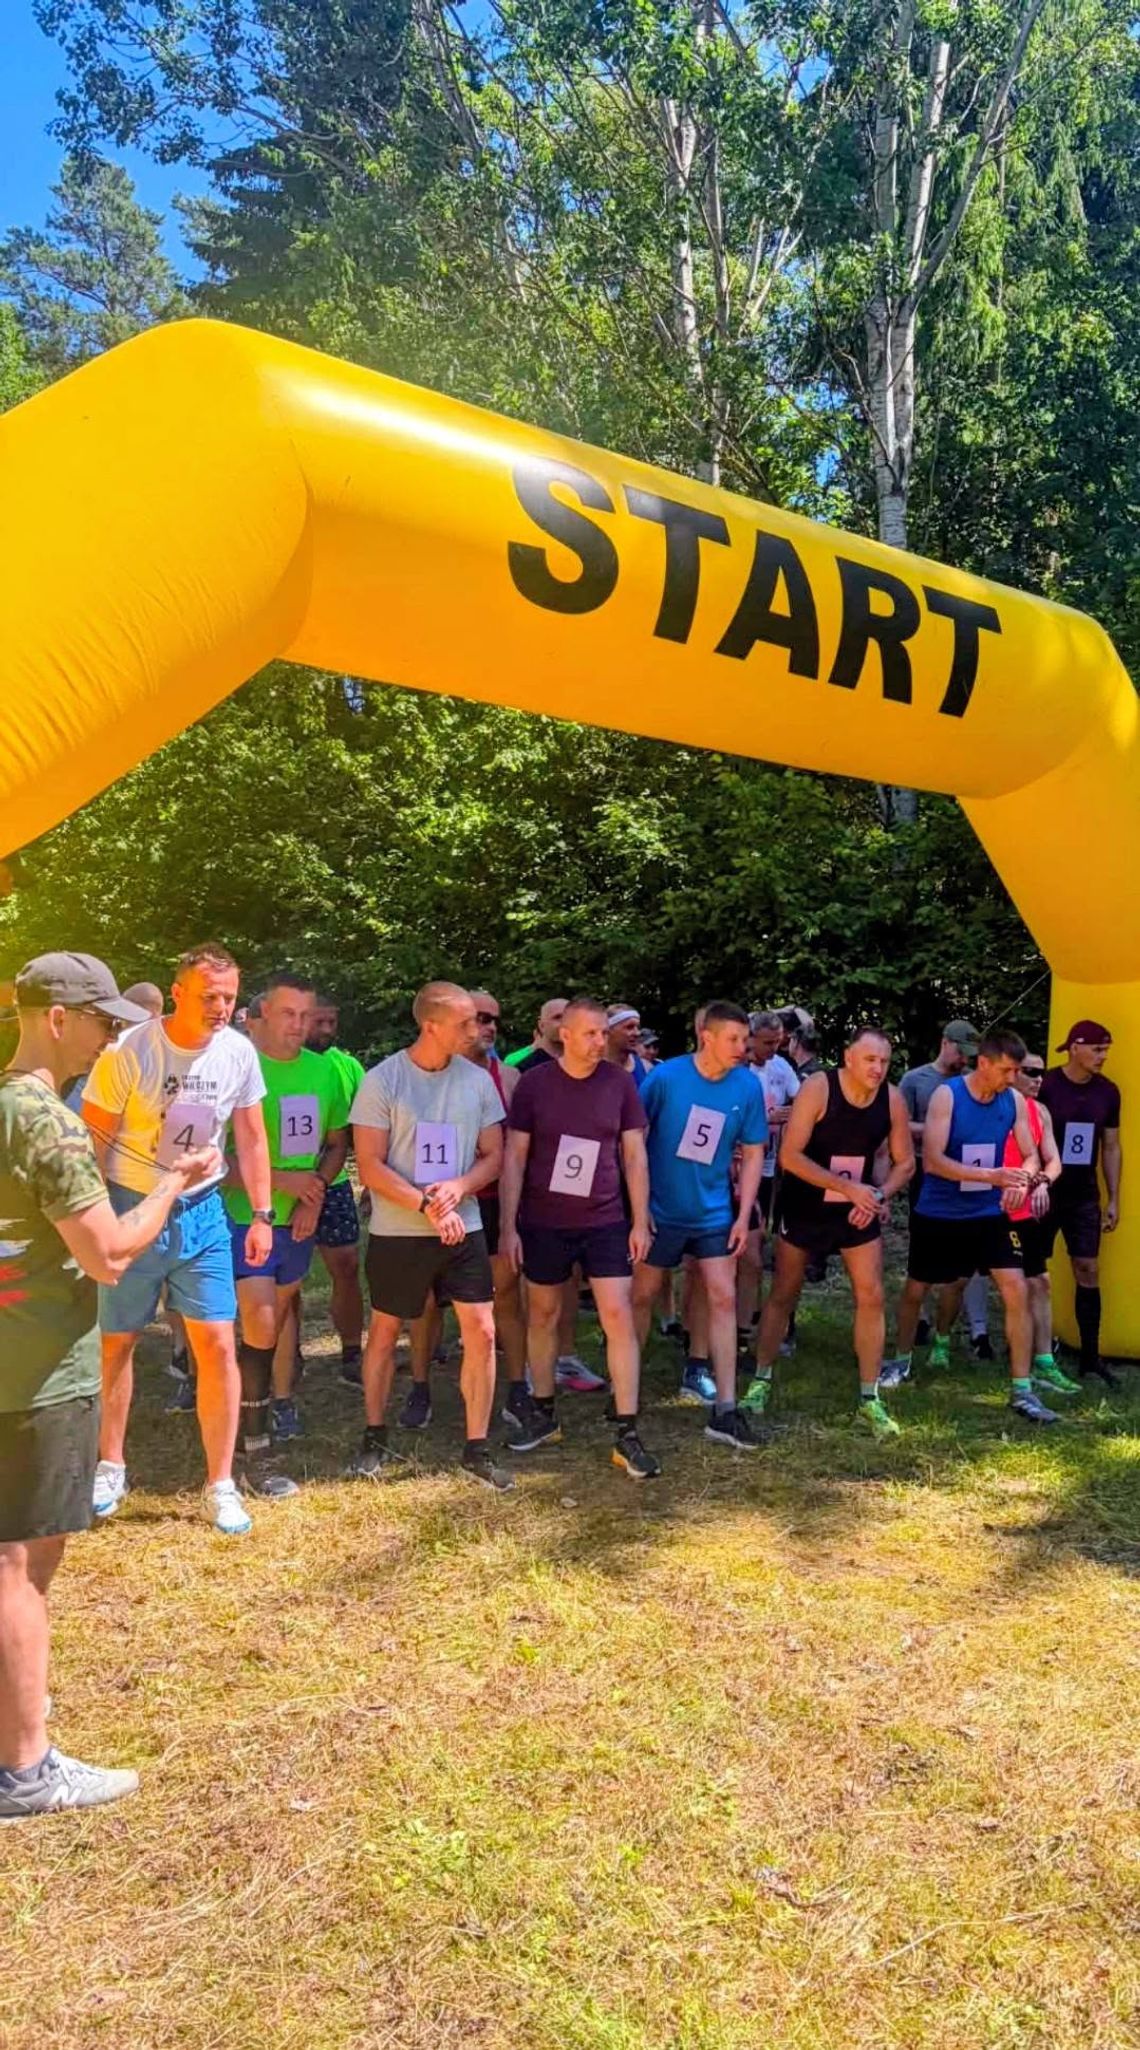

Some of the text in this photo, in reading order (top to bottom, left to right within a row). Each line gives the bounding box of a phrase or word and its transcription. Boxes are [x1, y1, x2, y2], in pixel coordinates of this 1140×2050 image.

[508, 455, 1002, 718] START
[287, 1115, 313, 1137] 13
[692, 1123, 712, 1147] 5
[173, 1124, 195, 1152] 4
[1071, 1134, 1084, 1154] 8
[422, 1143, 449, 1164] 11
